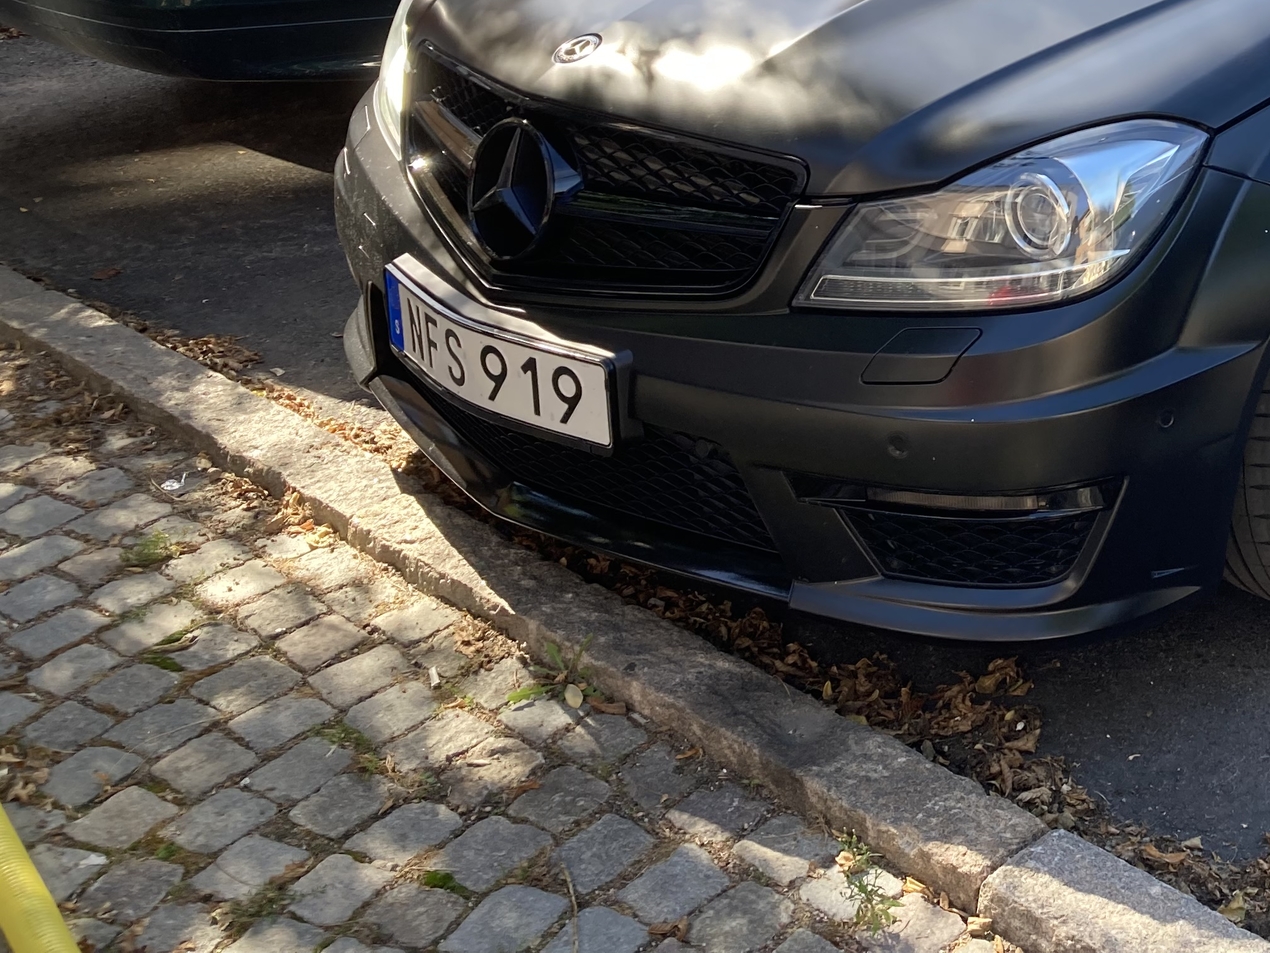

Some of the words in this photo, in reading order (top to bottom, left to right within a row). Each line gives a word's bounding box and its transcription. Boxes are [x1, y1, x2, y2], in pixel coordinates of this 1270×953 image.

[394, 319, 401, 335] S
[406, 297, 466, 387] NFS
[479, 344, 583, 425] 919
